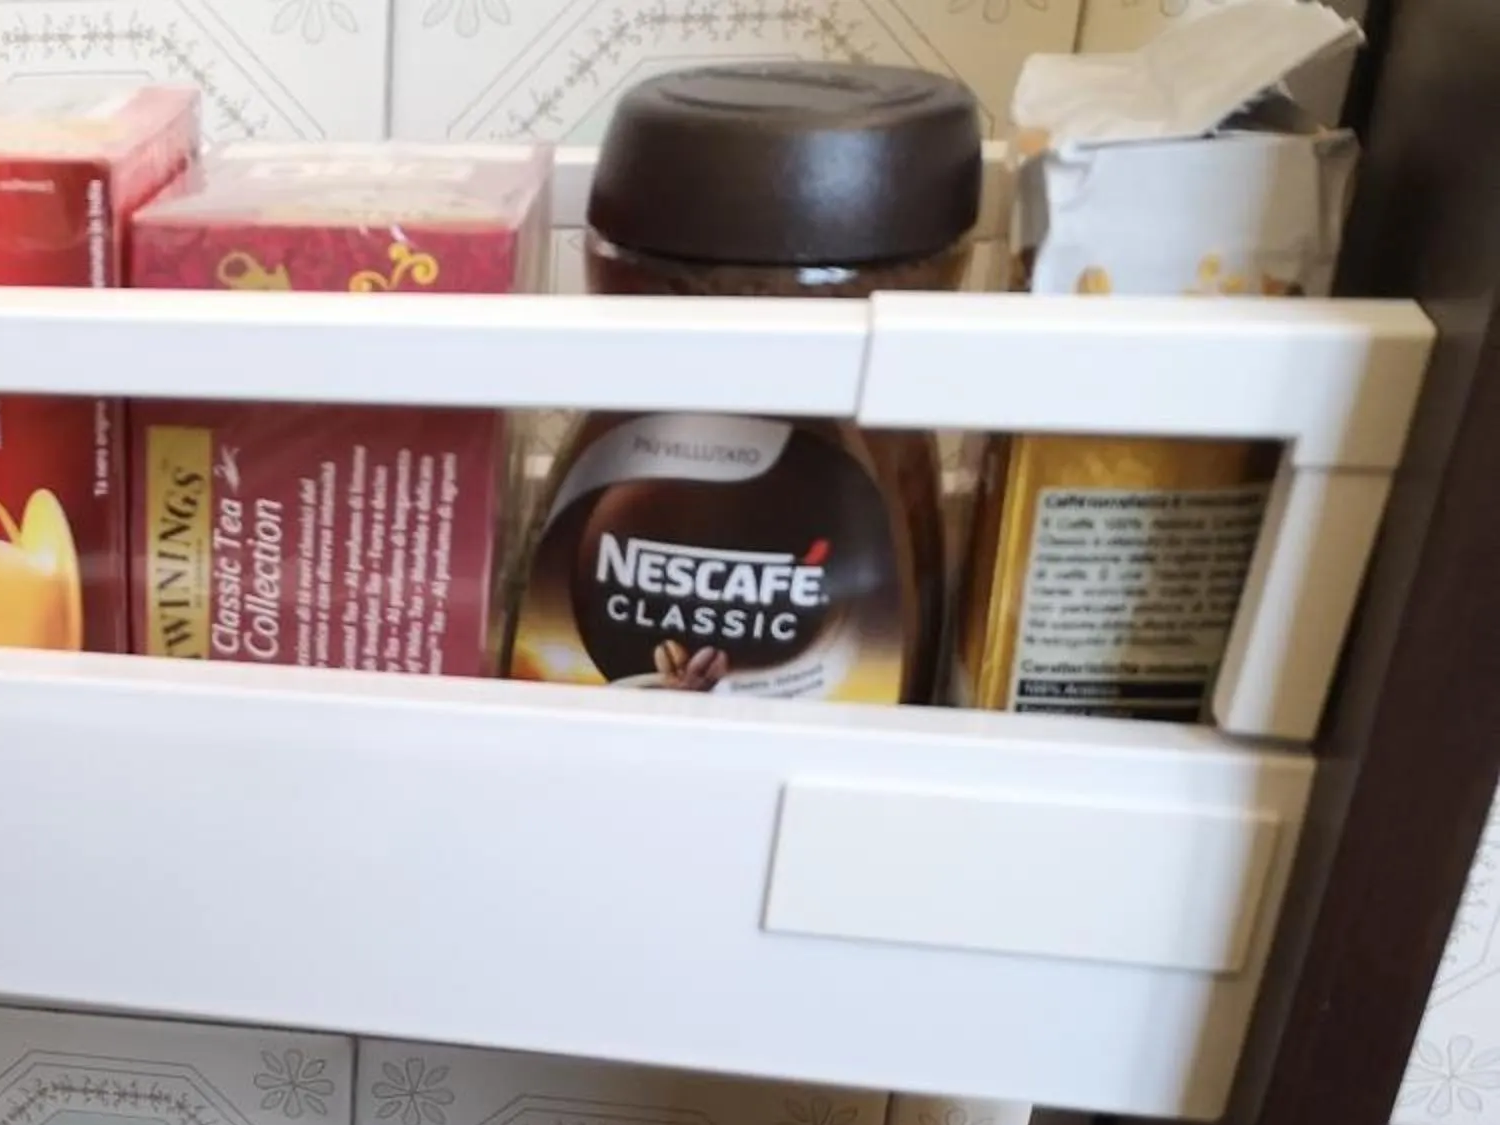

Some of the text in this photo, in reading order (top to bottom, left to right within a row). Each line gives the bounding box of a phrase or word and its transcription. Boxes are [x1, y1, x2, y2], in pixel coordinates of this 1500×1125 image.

[157, 466, 203, 658] WININGS
[211, 498, 243, 654] Classic Tea
[243, 498, 284, 659] Collection
[606, 595, 798, 642] CLASSIC
